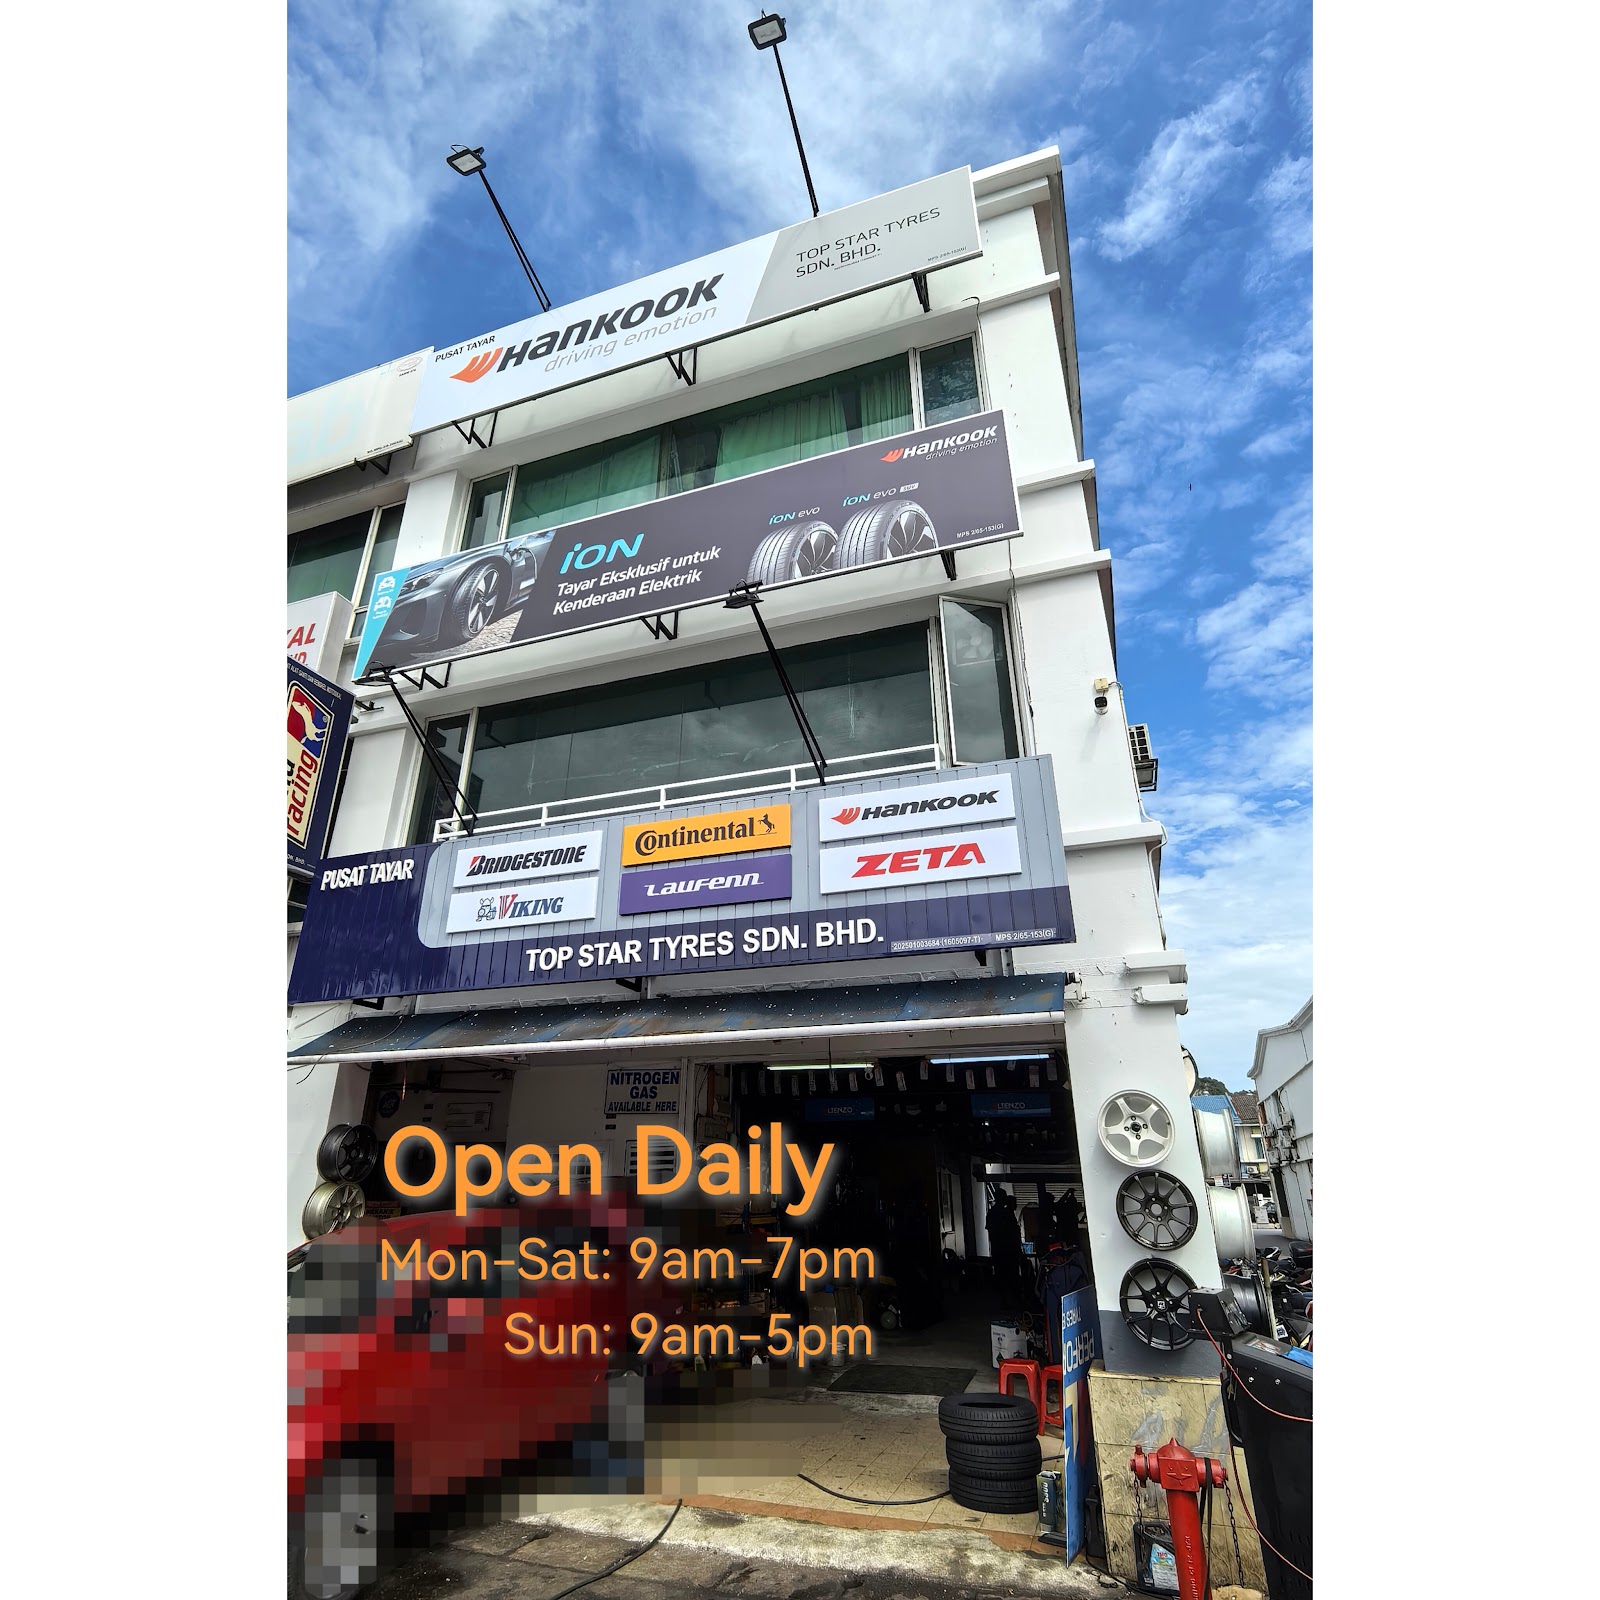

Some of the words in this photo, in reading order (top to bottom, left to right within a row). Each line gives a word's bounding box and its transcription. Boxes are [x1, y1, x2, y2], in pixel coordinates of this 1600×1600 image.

[796, 243, 831, 263] TOP
[835, 227, 880, 250] STAR
[884, 207, 941, 233] TYRES
[796, 257, 835, 278] SDN.
[840, 243, 881, 263] BHD.
[435, 346, 465, 362] PUSAT
[466, 335, 496, 352] TAYAR
[544, 339, 616, 373] driving
[624, 306, 717, 346] emotion
[925, 446, 957, 461] driving
[959, 437, 998, 452] emotion
[873, 486, 897, 499] evo
[798, 506, 821, 518] evo
[956, 531, 970, 539] MPS
[557, 577, 597, 598] Tayar
[599, 560, 671, 588] Eksklusif
[672, 545, 722, 570] untuk
[553, 585, 637, 616] Kenderaan
[638, 569, 703, 596] Elektrik
[287, 749, 319, 836] racing
[634, 817, 755, 857] Continental
[320, 864, 368, 891] PUSAT
[369, 858, 415, 884] TAYAR
[466, 844, 588, 877] BRIDGESTONE
[851, 842, 986, 878] ZETA
[498, 893, 564, 920] VIKING
[526, 946, 573, 973] TOP
[577, 937, 642, 969] STAR
[649, 930, 734, 962] TYRES
[742, 925, 807, 954] SDN.
[815, 918, 884, 948] BHD.
[996, 933, 1012, 941] MPS
[1012, 929, 1054, 940] 2/65-153(G)
[610, 1071, 680, 1086] NITROGEN
[629, 1086, 658, 1100] GAS
[607, 1101, 651, 1112] AVAILABLE
[655, 1101, 677, 1112] HERE
